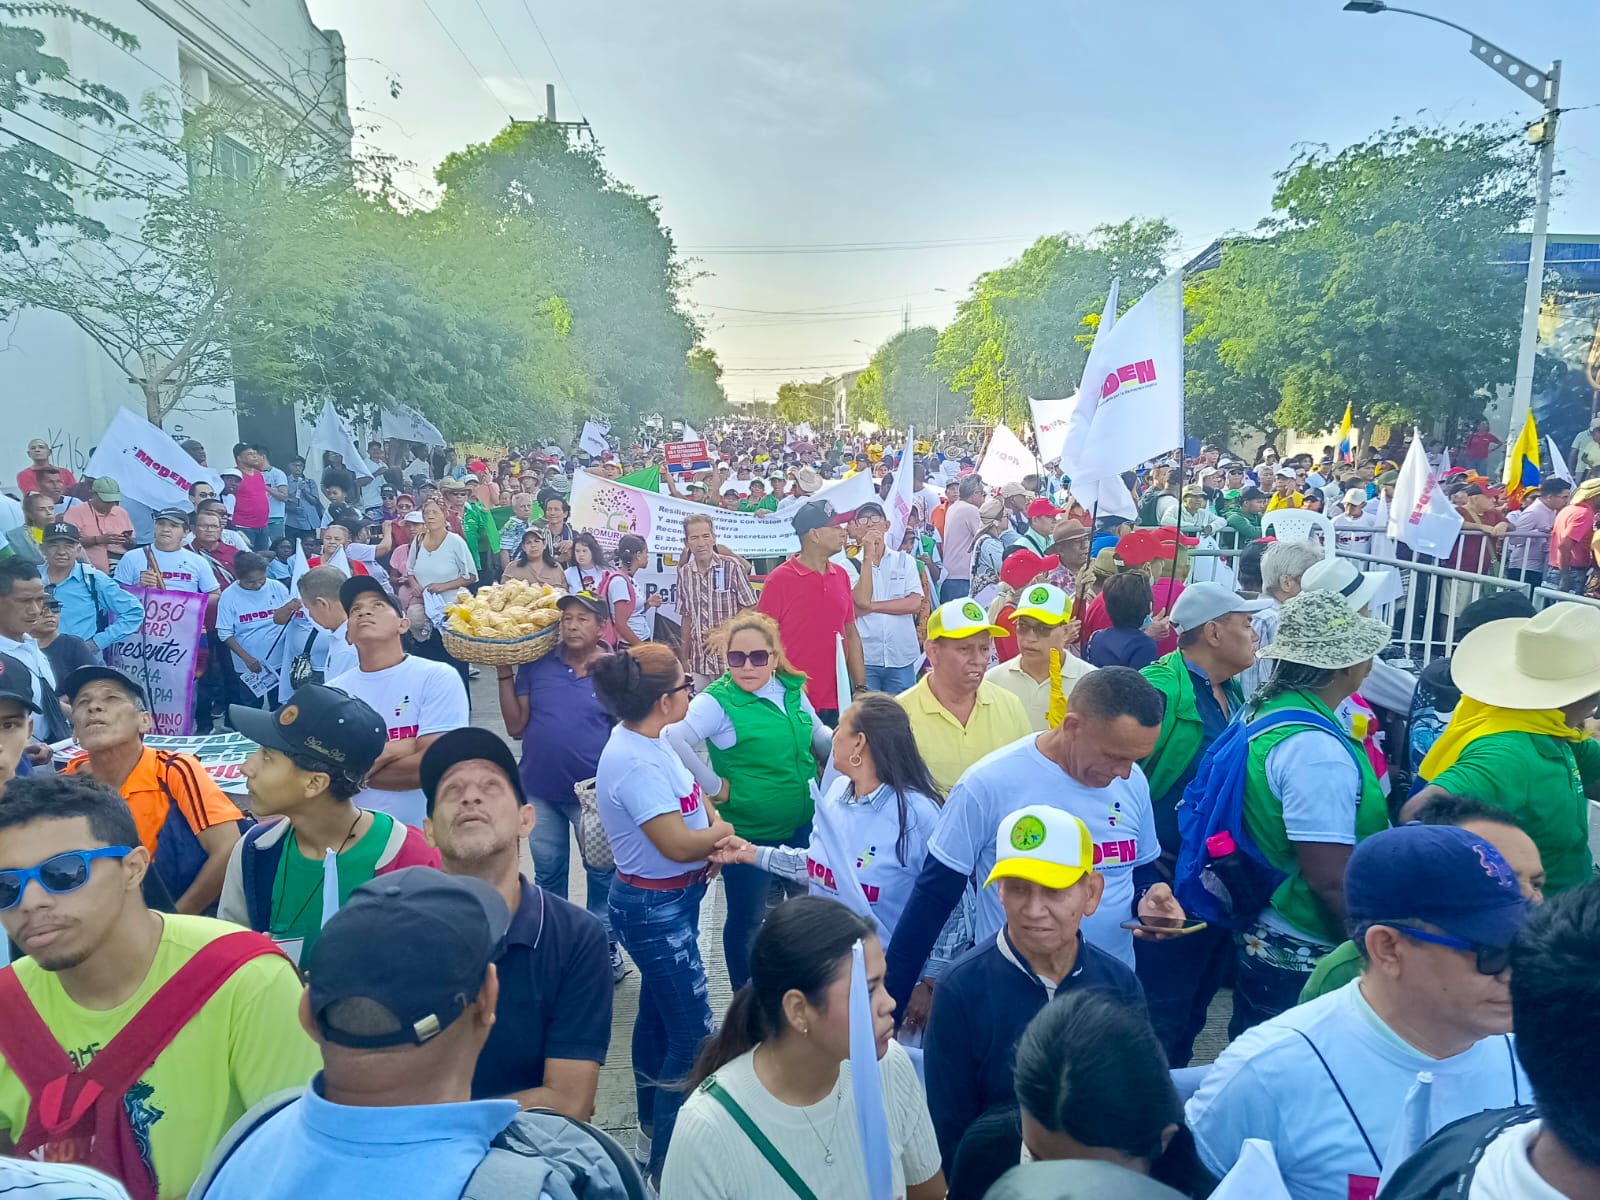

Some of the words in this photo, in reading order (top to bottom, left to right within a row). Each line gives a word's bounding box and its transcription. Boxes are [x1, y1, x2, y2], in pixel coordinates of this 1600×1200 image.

[1102, 359, 1157, 400] DEN
[134, 449, 192, 491] MODEN
[658, 505, 694, 516] Resilien
[160, 571, 192, 581] DEN
[645, 583, 677, 603] Ref
[145, 597, 189, 623] OSÓ
[239, 609, 276, 623] MODE
